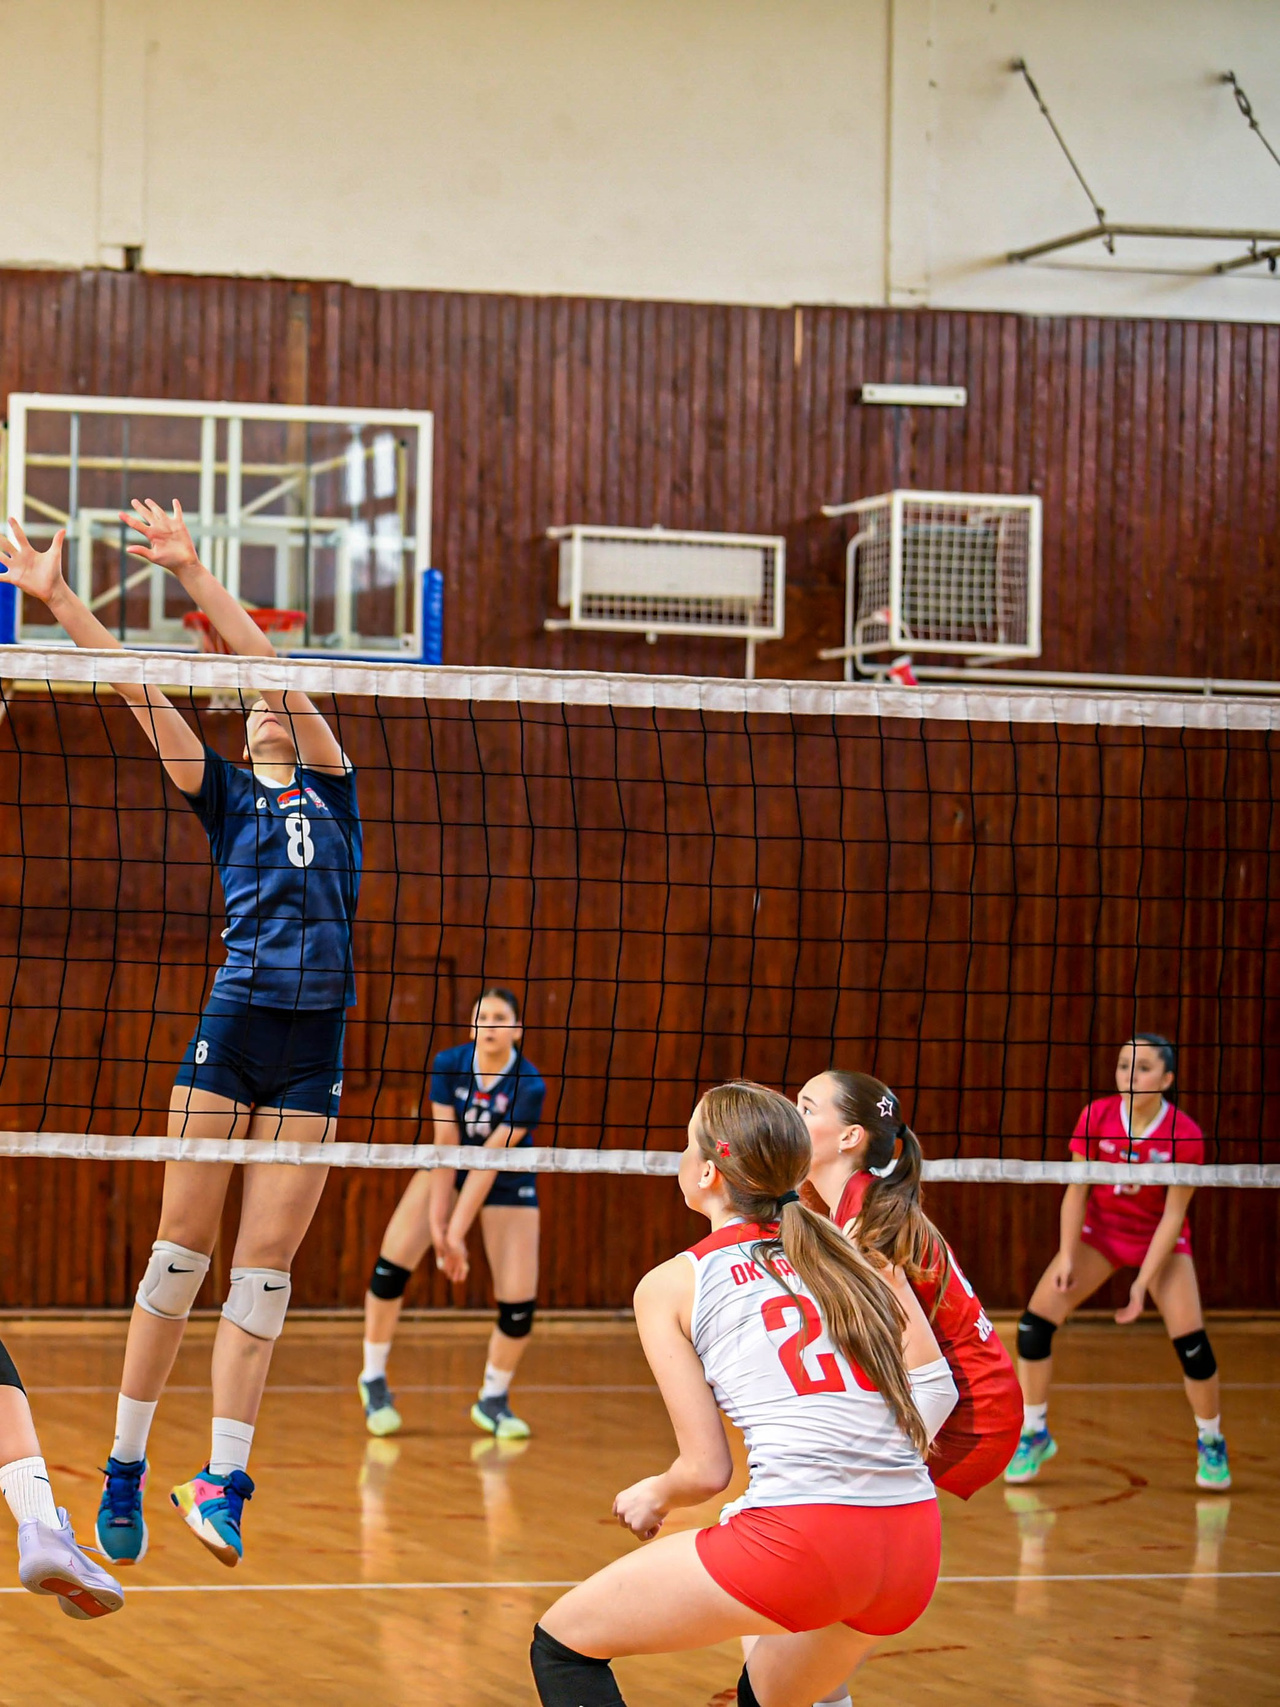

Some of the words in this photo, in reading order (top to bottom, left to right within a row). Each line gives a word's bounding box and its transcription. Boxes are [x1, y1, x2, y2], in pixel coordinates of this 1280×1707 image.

[285, 812, 315, 868] 8
[195, 1040, 210, 1064] 8
[760, 1294, 880, 1397] 2
